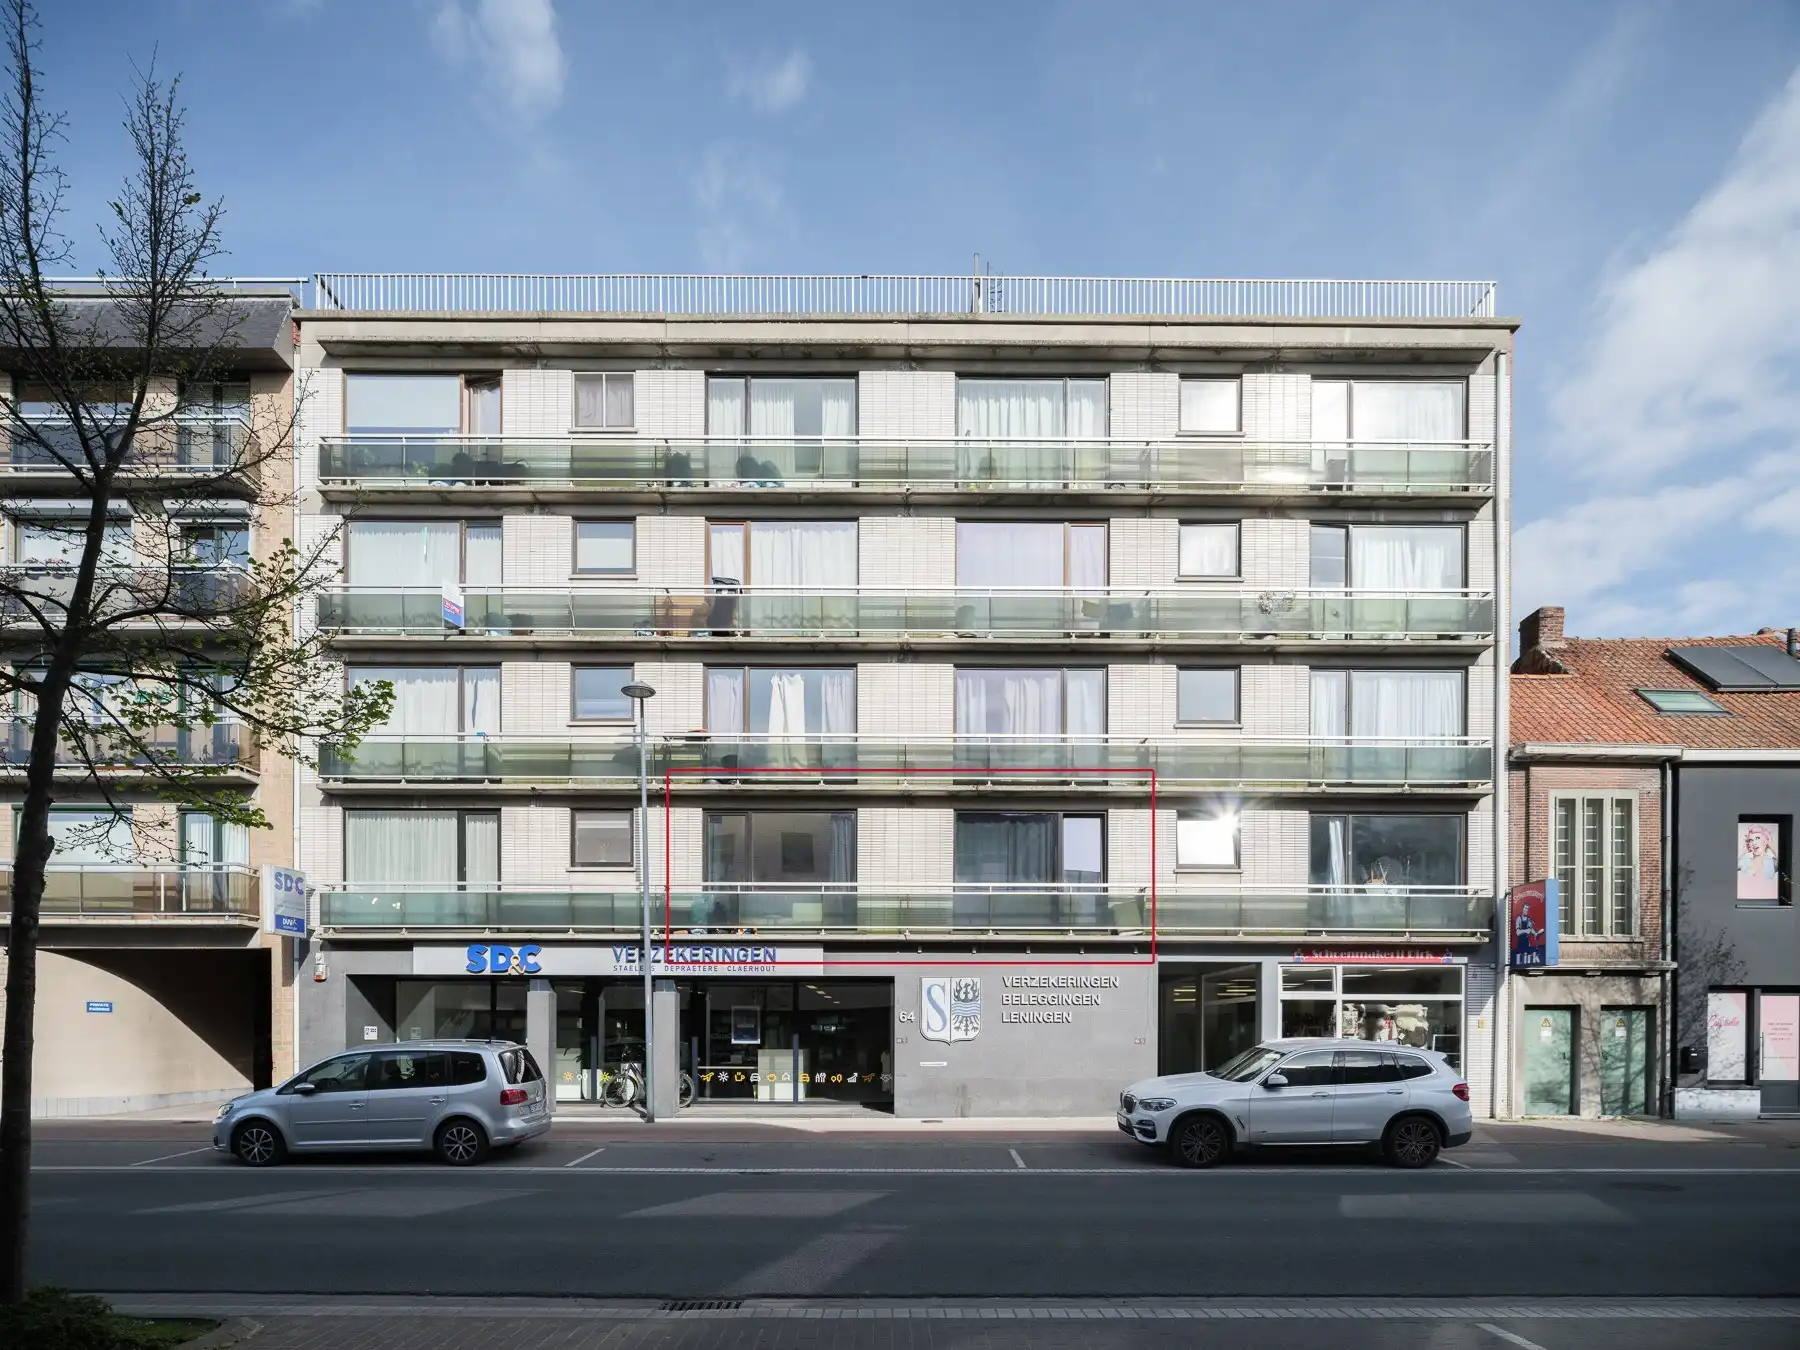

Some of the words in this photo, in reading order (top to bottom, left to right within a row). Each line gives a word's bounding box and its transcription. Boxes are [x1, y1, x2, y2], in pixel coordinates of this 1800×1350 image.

[1516, 952, 1540, 965] Dirk
[1002, 976, 1119, 988] VERZEKERINGEN
[1002, 993, 1100, 1006] BELEGGINGEN
[899, 1011, 915, 1023] 64
[1002, 1011, 1072, 1024] LENINGEN
